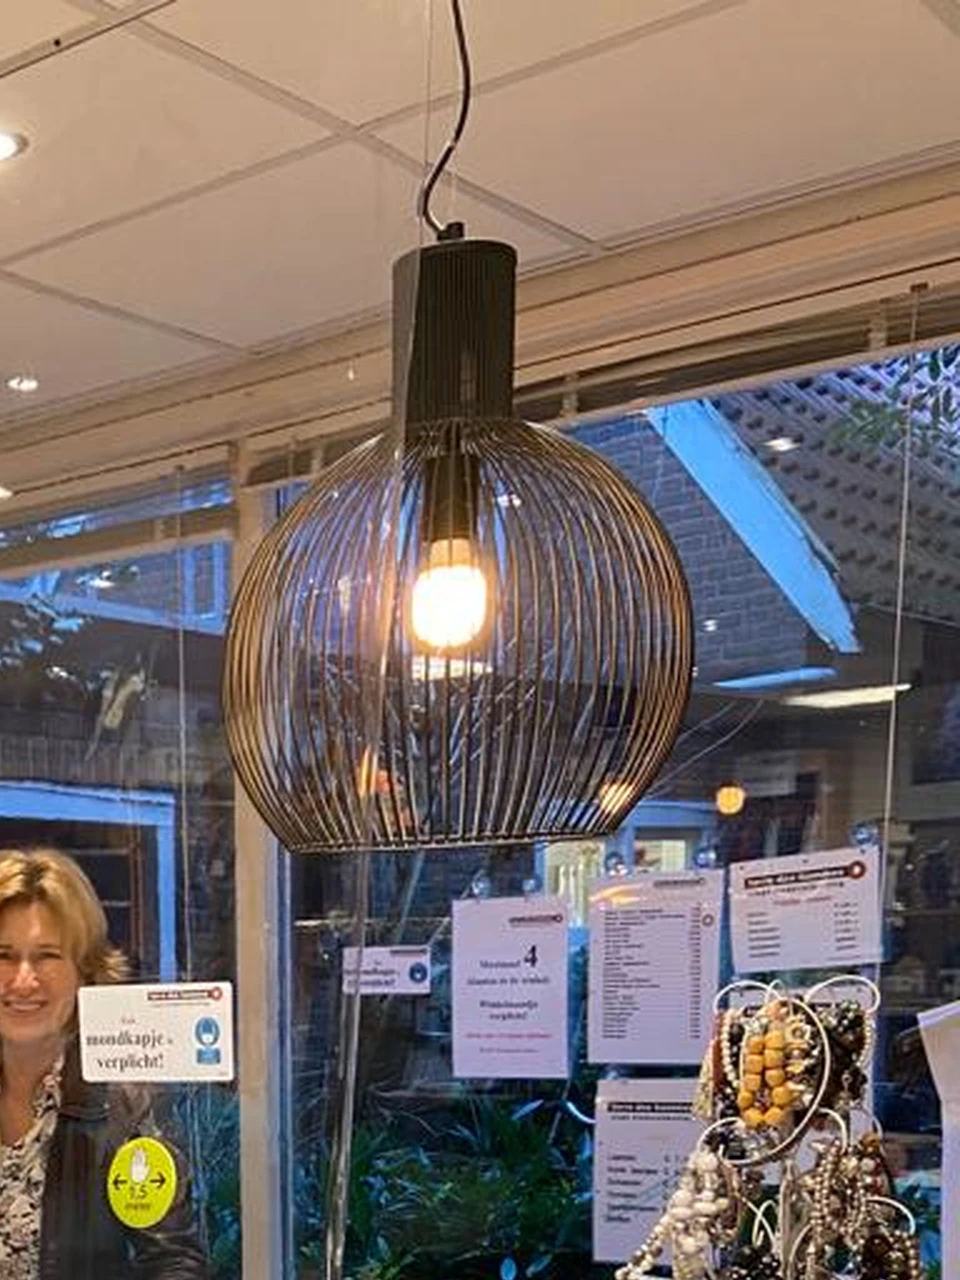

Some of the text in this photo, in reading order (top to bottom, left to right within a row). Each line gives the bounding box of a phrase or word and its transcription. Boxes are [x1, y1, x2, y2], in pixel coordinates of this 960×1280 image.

[523, 944, 538, 968] 4
[85, 1029, 164, 1049] mondkapje
[96, 1053, 164, 1073] verplicht!
